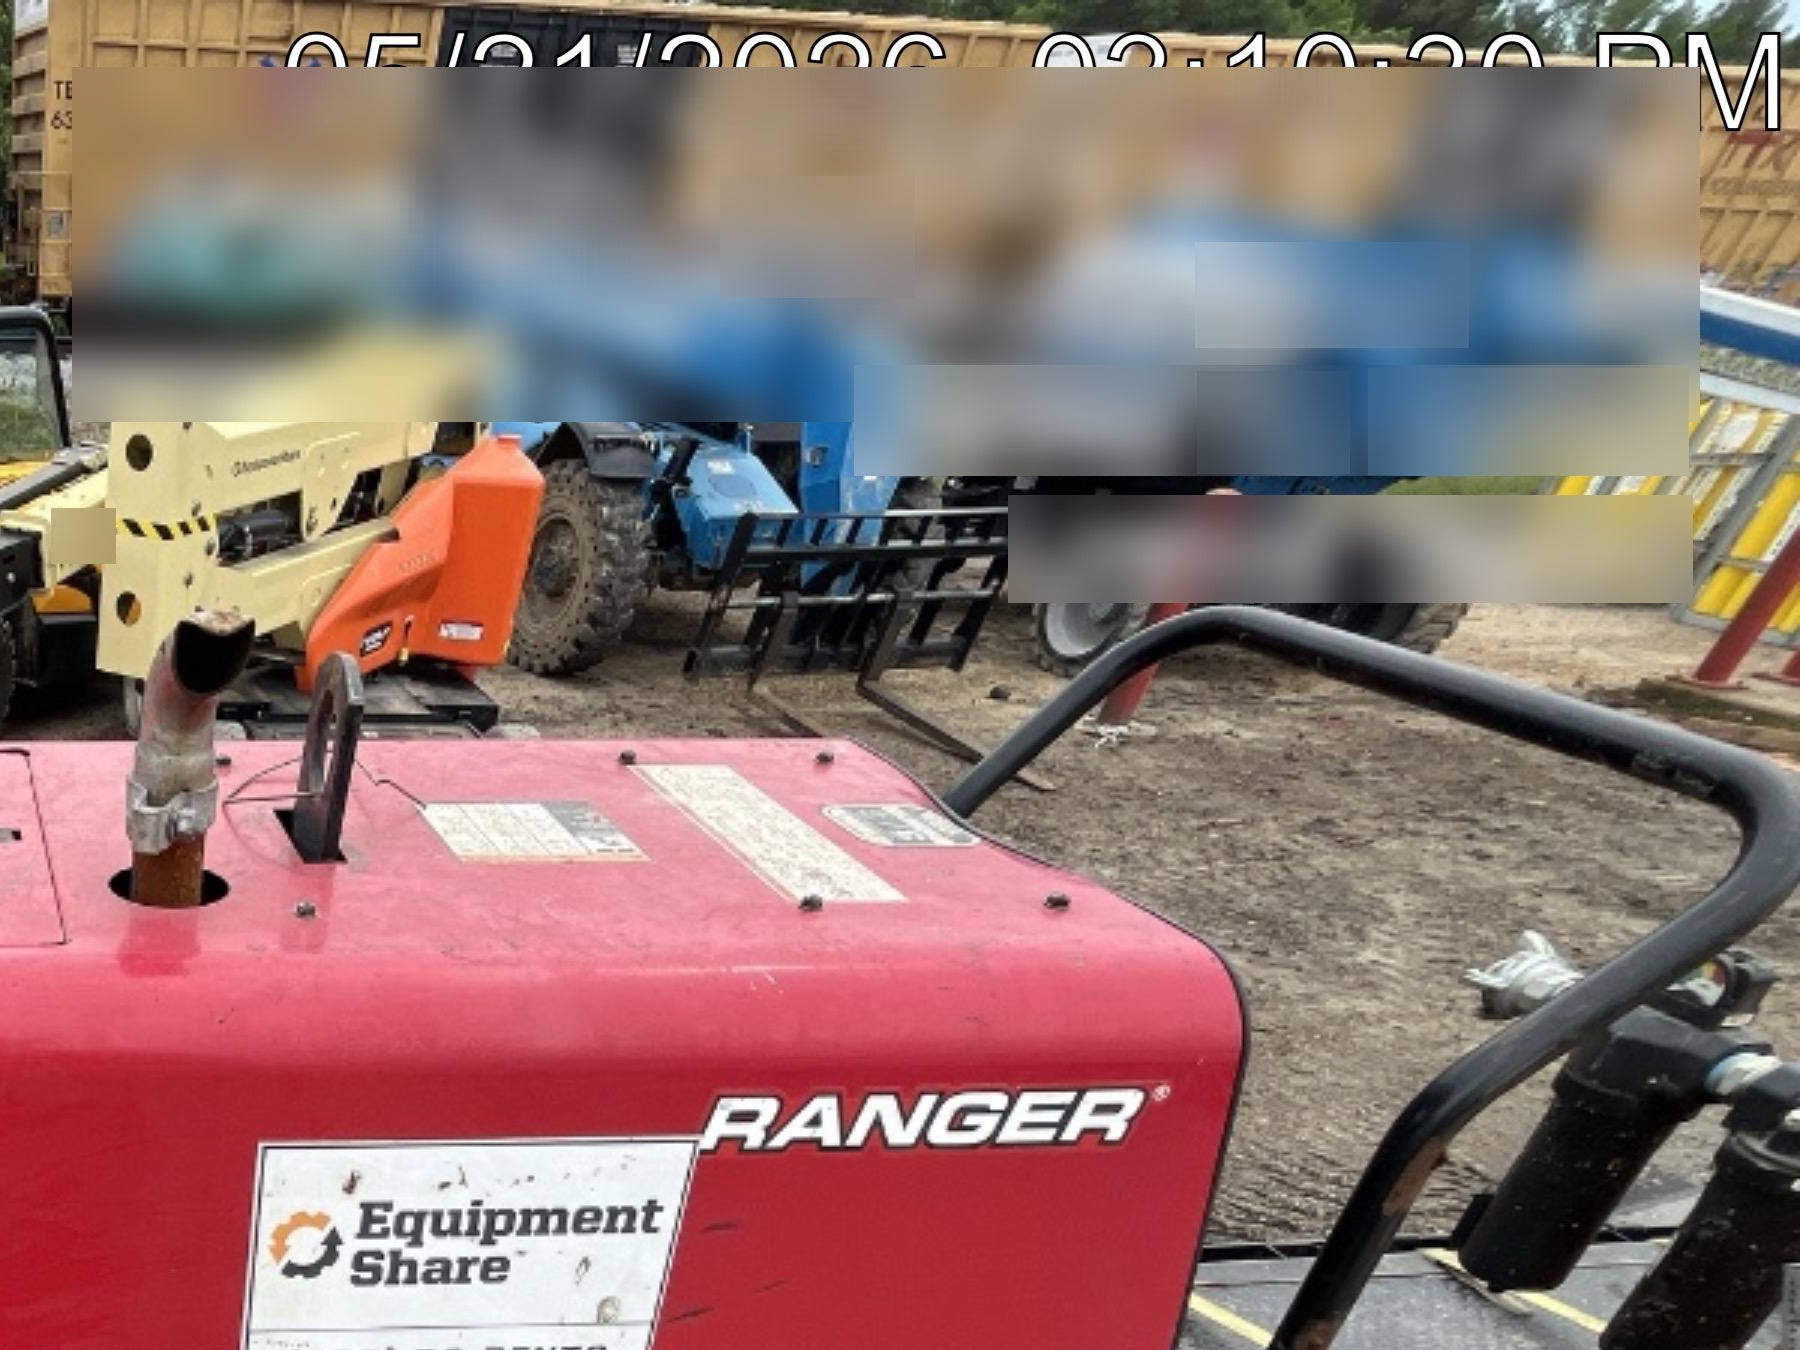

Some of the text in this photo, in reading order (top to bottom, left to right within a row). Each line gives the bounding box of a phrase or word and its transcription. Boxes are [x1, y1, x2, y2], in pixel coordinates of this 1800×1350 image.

[700, 1086, 1147, 1154] RANGER
[355, 1199, 662, 1246] Equipment
[350, 1249, 511, 1287] Share
